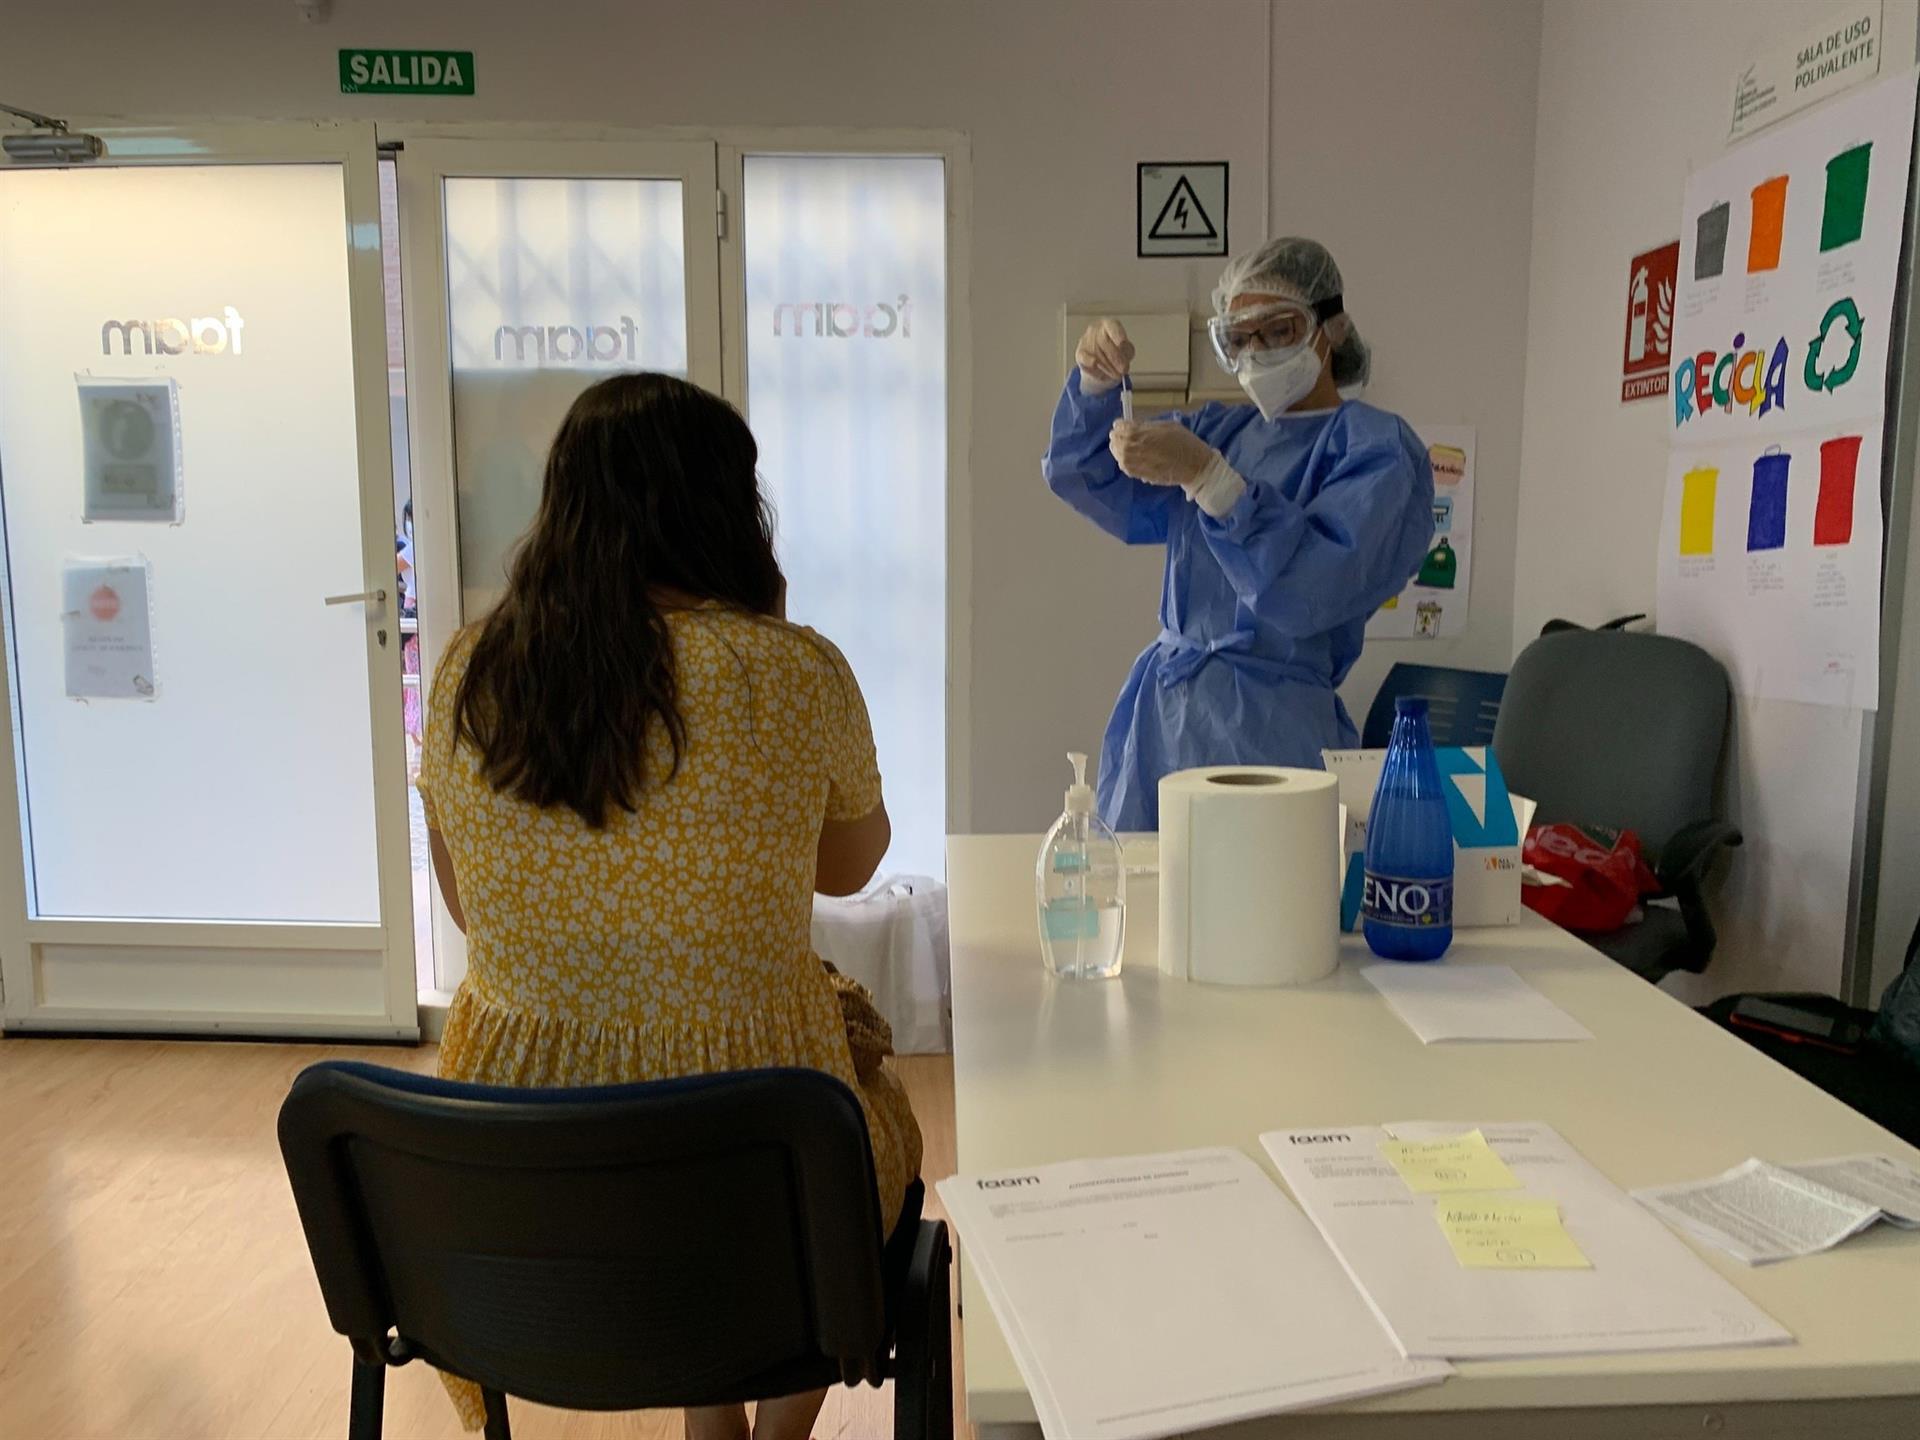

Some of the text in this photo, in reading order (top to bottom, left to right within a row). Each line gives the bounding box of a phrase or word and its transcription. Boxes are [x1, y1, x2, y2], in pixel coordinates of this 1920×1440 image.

[1796, 15, 1871, 69] SALA DE USO
[350, 53, 464, 86] SALIDA
[1794, 37, 1874, 93] POLIVALENTE
[1625, 375, 1667, 400] EXTINTOR
